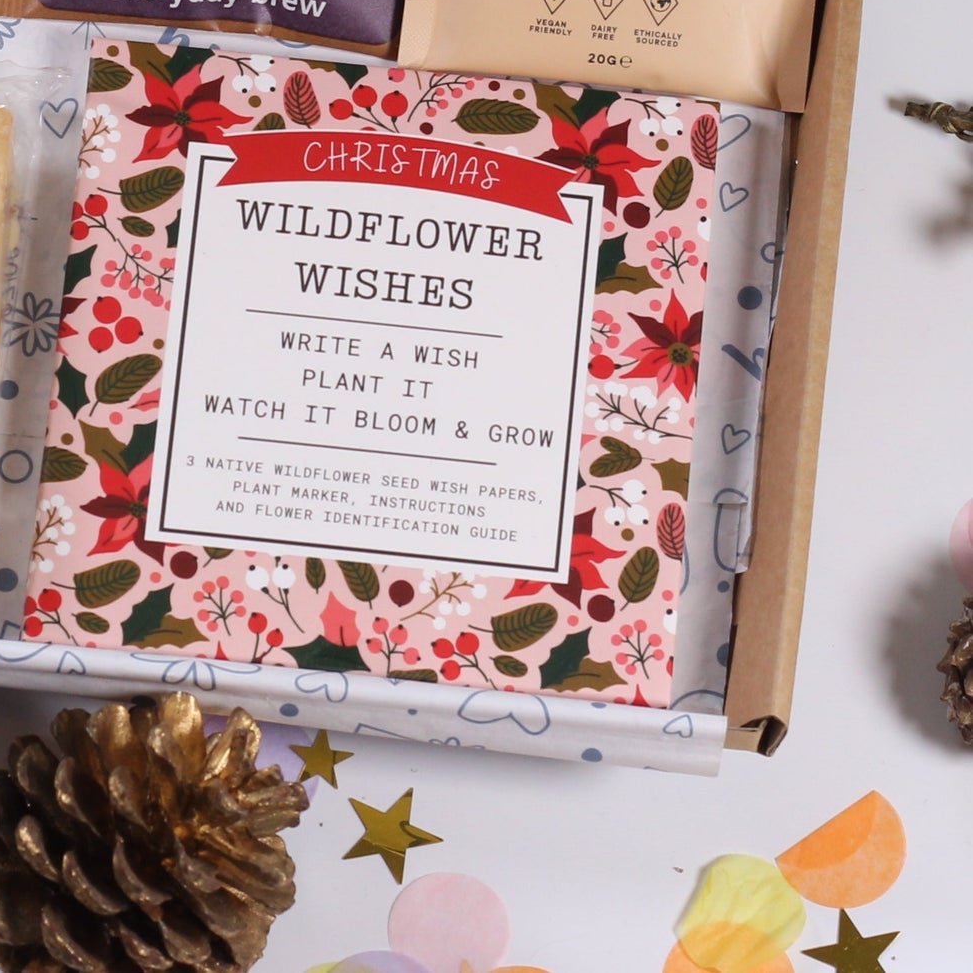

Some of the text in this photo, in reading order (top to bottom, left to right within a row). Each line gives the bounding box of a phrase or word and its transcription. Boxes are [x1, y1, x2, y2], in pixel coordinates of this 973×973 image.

[529, 25, 572, 36] FRIENDLY
[536, 18, 567, 27] VEGAN
[591, 25, 617, 33] DAIRY
[592, 33, 615, 41] FREE
[634, 29, 682, 40] ETHICALLY
[636, 37, 678, 47] SOURCED
[303, 142, 500, 189] CHRISTMAS
[236, 199, 543, 261] WILDFLOWER
[295, 262, 473, 310] WISHES
[280, 332, 478, 369] WRITE A WISH
[302, 369, 434, 399] PLANT IT
[204, 395, 554, 447] WATCH IT BLOOM & GROW
[187, 455, 544, 504] 3 NATIVE WILDFLOWER SEED WISH PAPERS,
[233, 481, 486, 518] PLANT MARKER, INSTRUCTIONS
[216, 500, 518, 542] AND FLOWER IDENTIFICATION GUIDE
